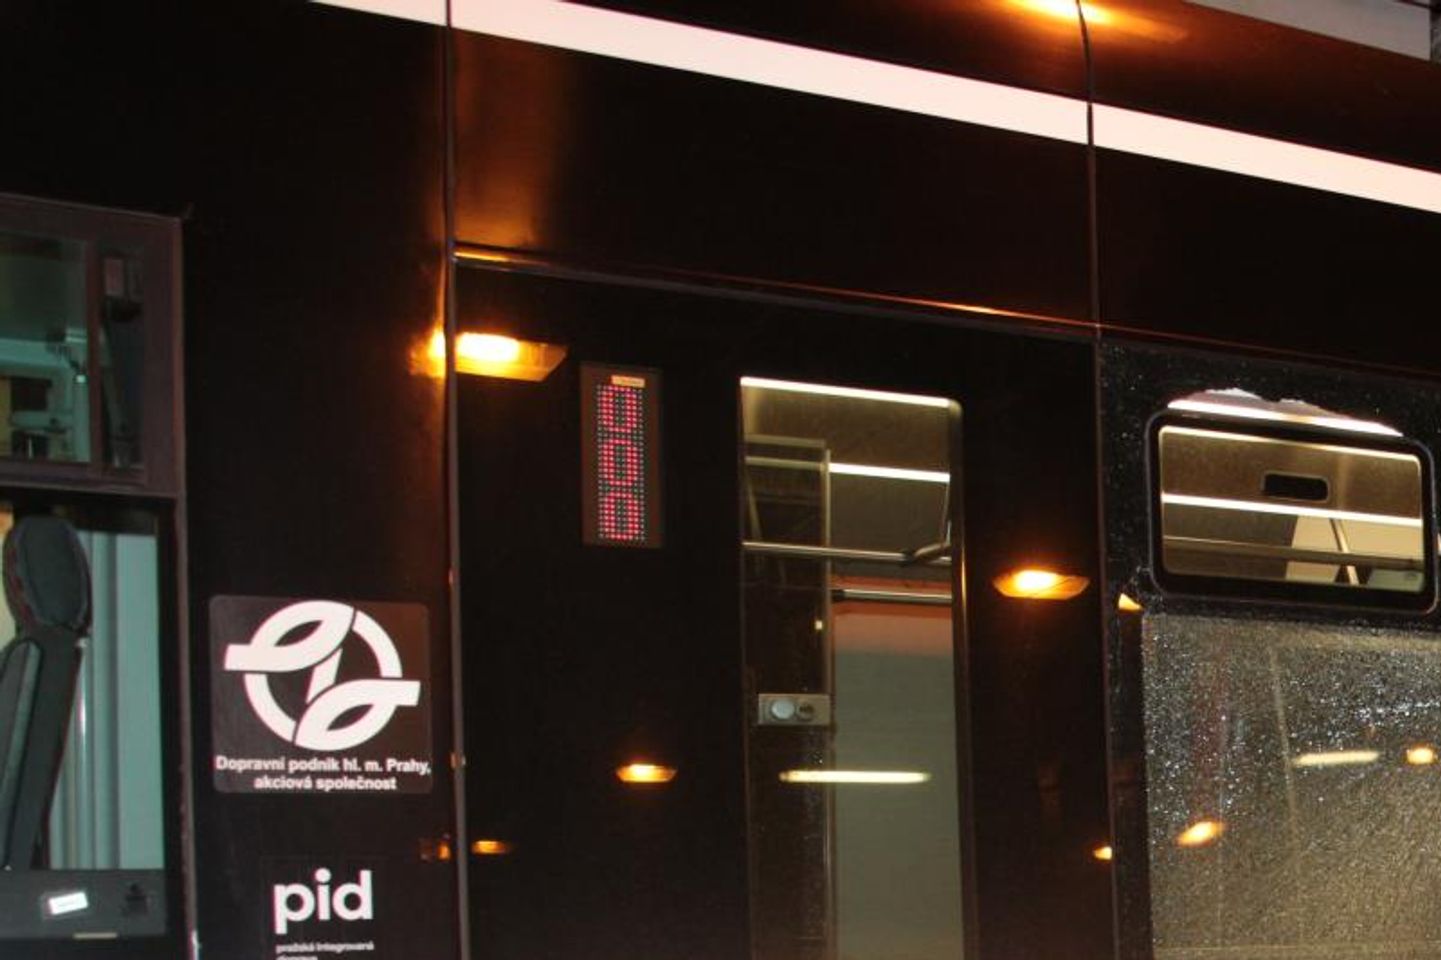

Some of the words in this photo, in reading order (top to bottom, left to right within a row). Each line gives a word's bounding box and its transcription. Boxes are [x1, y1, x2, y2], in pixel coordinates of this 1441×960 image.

[215, 756, 285, 773] Dopravní
[288, 758, 340, 774] podnik
[343, 760, 361, 771] hl.
[364, 761, 383, 772] m.
[386, 759, 432, 776] Prahy,
[254, 774, 313, 790] akciová
[316, 775, 397, 792] společnost
[274, 867, 373, 935] pid
